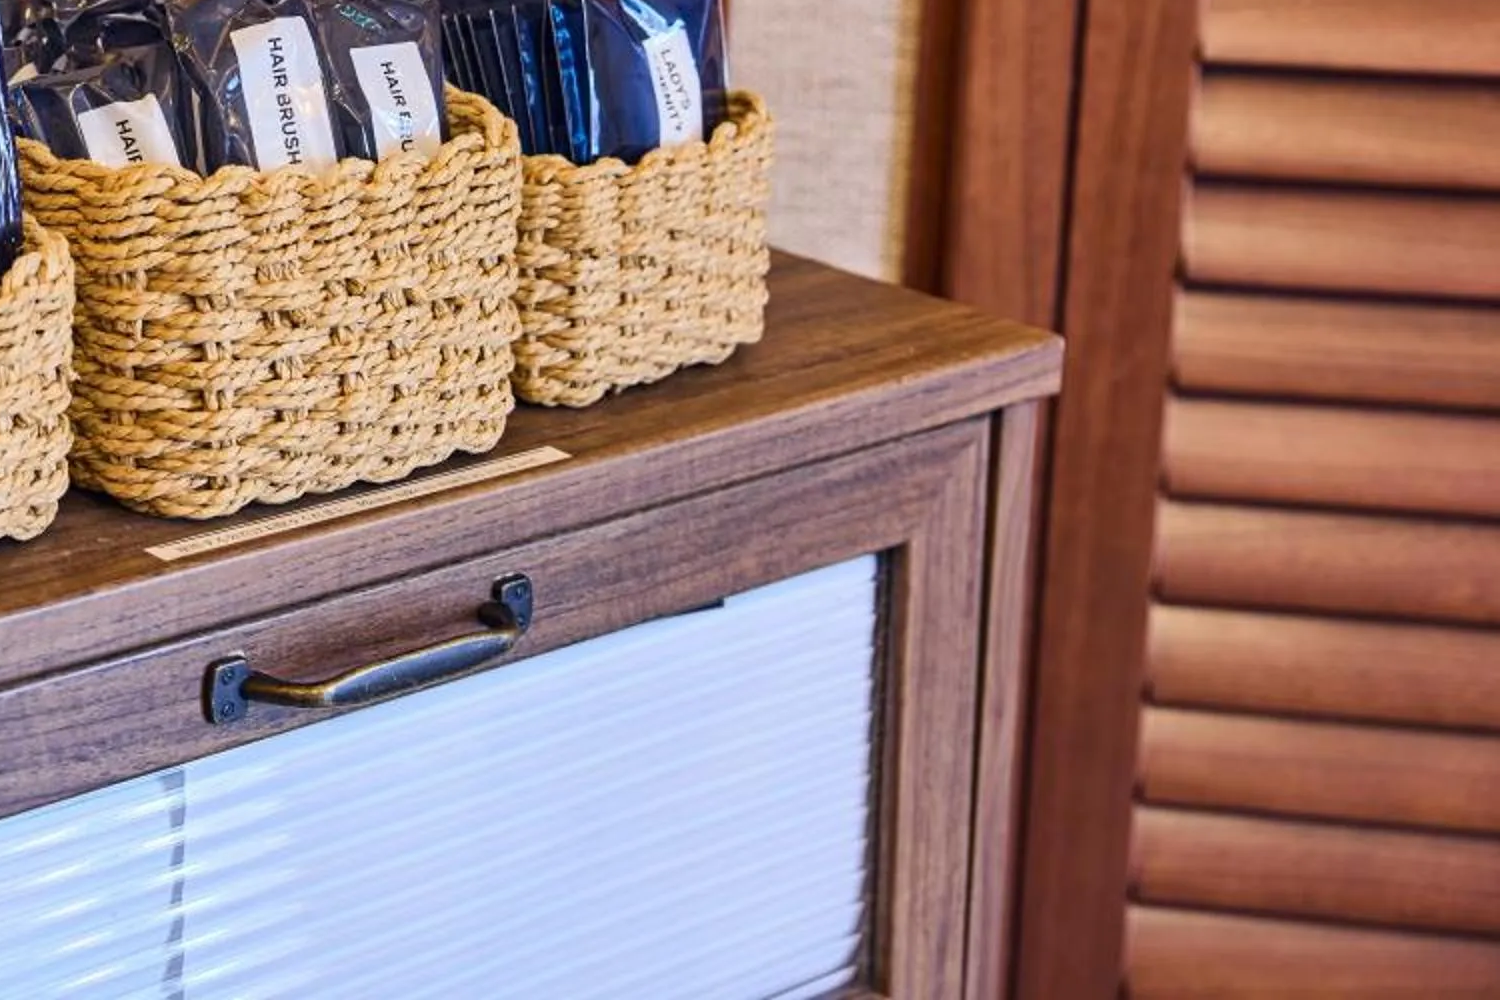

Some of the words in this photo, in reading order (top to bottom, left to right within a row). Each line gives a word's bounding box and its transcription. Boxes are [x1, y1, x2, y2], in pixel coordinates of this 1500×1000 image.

[268, 36, 289, 88] HAIR
[276, 94, 304, 165] BRUSH
[380, 61, 407, 106] HAIR
[399, 111, 414, 153] BRU
